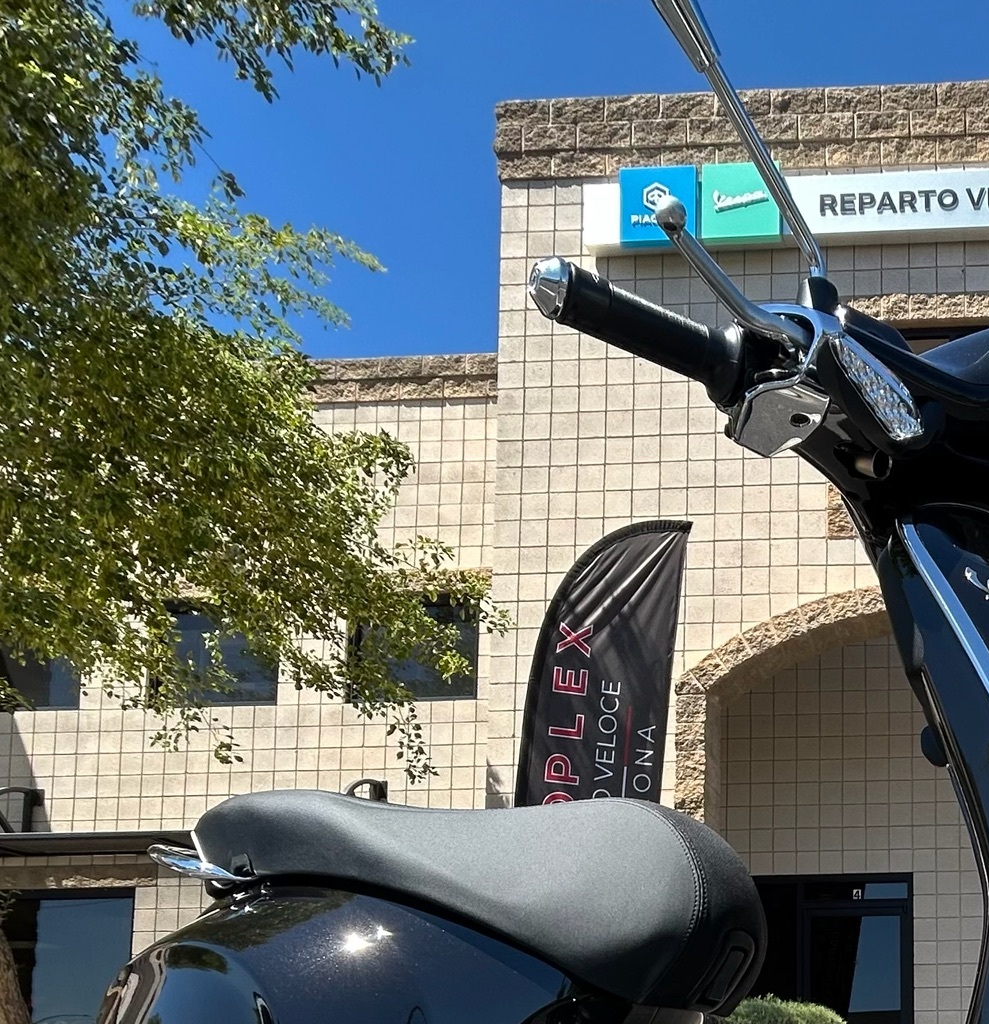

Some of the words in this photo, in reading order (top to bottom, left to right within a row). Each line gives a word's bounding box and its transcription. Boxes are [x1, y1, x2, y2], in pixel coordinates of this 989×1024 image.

[819, 188, 959, 216] REPARTO
[593, 680, 622, 782] VELOCE
[853, 889, 861, 900] 4
